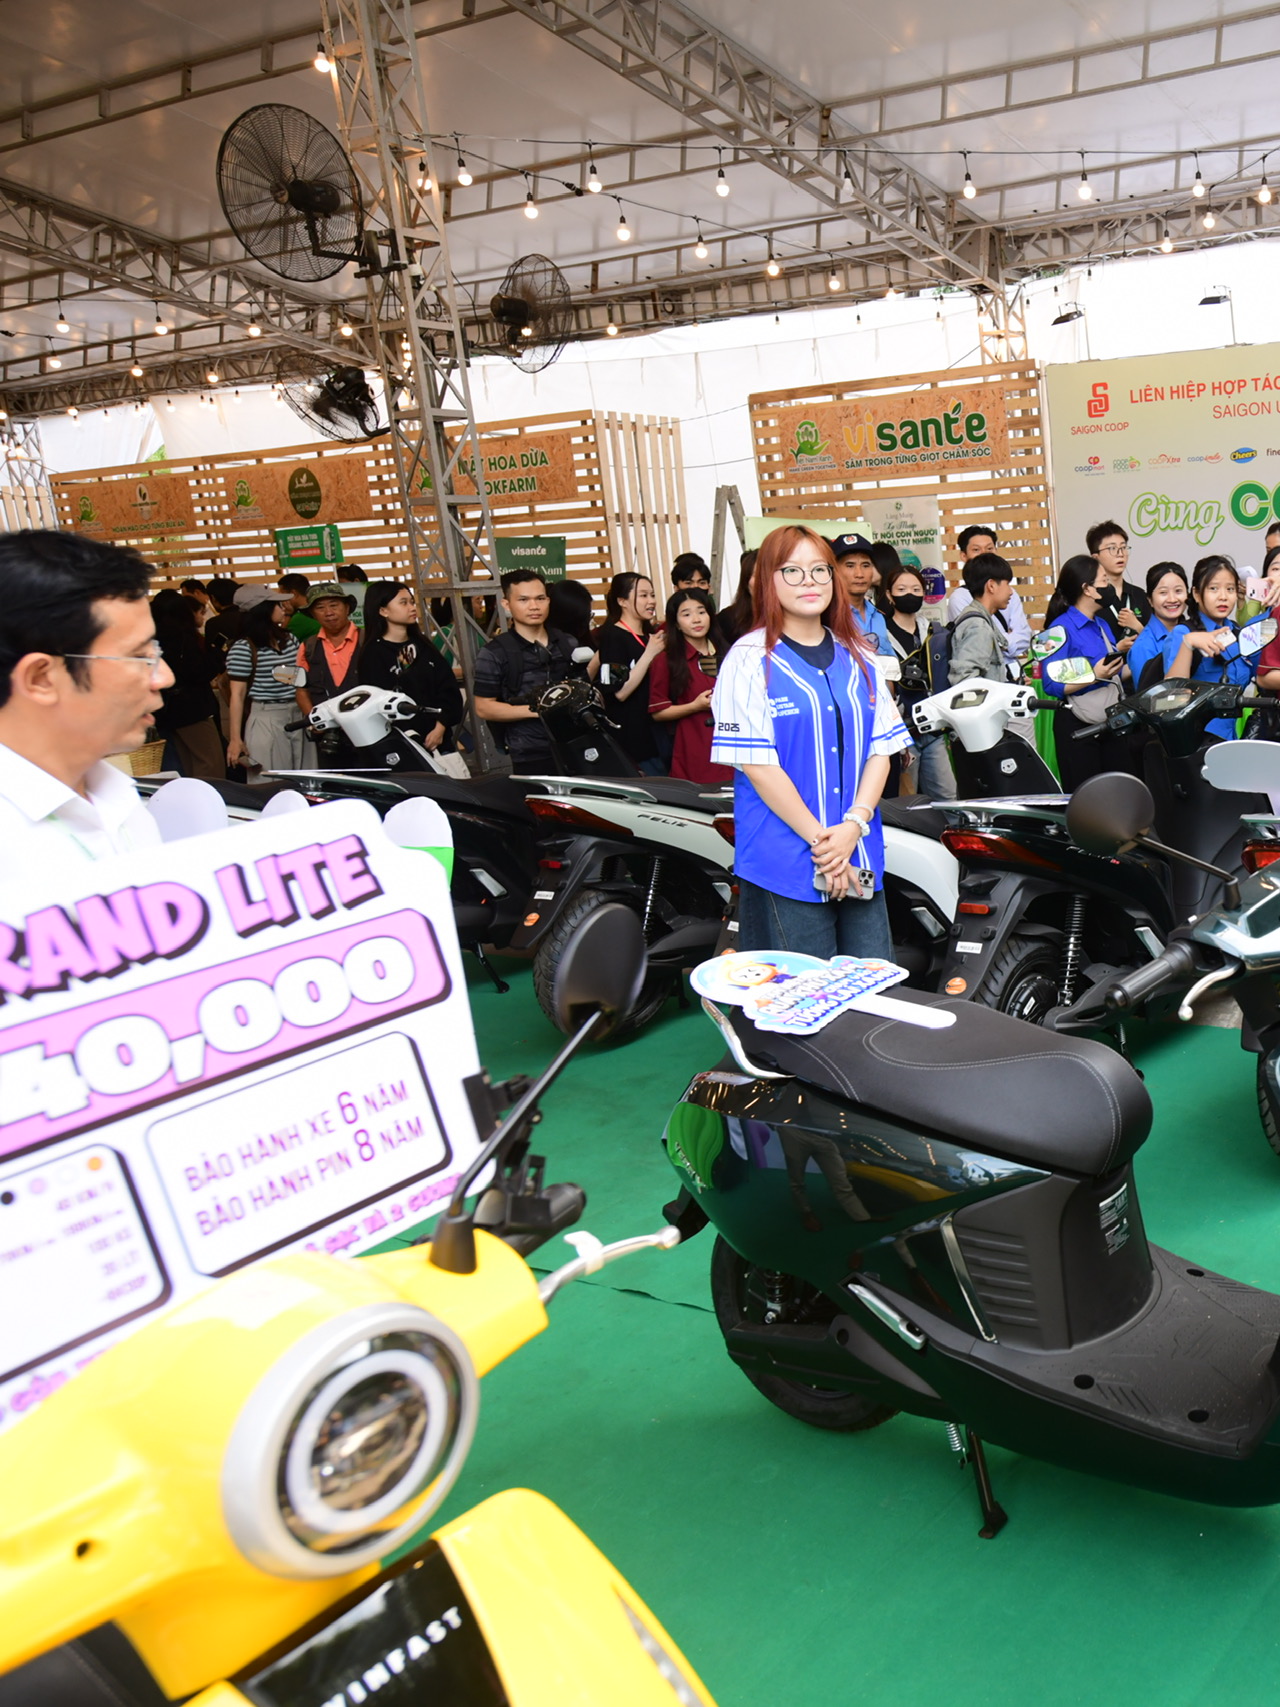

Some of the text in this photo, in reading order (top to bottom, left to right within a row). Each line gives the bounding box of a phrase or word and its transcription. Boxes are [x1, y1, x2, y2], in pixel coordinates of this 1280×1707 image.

[1129, 383, 1165, 404] LIÊN
[1170, 379, 1207, 402] HIỆP
[1211, 378, 1248, 399] HỢP
[1212, 400, 1272, 420] SAIGON
[1070, 424, 1102, 436] SAIGON
[488, 455, 518, 472] HOA
[520, 447, 549, 468] DỪA
[845, 458, 863, 469] SÂM
[864, 456, 893, 468] TRONG
[895, 452, 918, 464] TỪNG
[920, 452, 940, 464] GIỌT
[971, 447, 991, 457] SÓC
[1230, 449, 1258, 461] Cheers
[476, 476, 537, 496] OKFARM
[1128, 491, 1225, 545] Cùng
[511, 545, 547, 556] visante
[718, 722, 740, 732] 2025
[636, 814, 689, 829] FELIZ
[213, 834, 385, 939] LITE
[184, 1151, 235, 1193] BẢO
[237, 1124, 303, 1169] HÀNH
[304, 1109, 336, 1141] XE
[337, 1090, 359, 1125] 6
[195, 1195, 247, 1237] BẢO
[248, 1163, 315, 1212] HÀNH
[315, 1147, 353, 1182] PIN
[353, 1127, 375, 1163] 8
